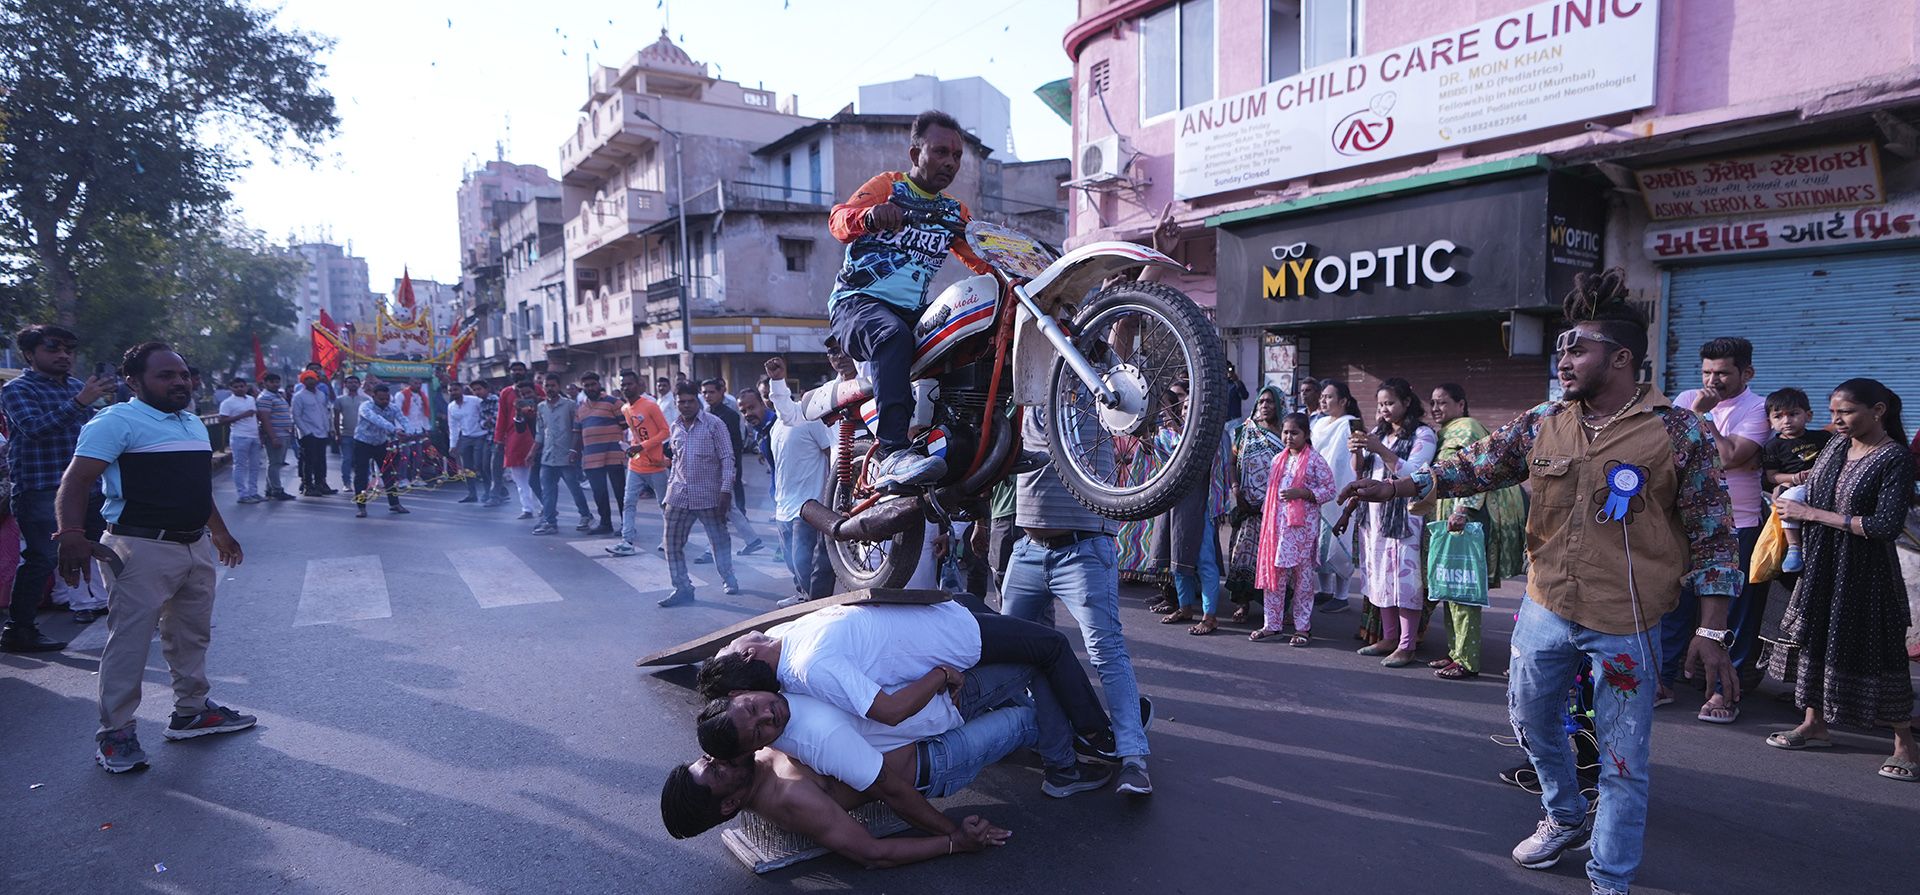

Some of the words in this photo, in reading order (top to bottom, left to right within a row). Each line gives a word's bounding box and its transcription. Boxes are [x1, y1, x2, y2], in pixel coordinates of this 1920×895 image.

[1181, 92, 1266, 137] ANJUM
[1276, 64, 1366, 111] CHILD
[1380, 29, 1480, 82] CARE
[1494, 0, 1643, 50] CLINIC
[1439, 72, 1463, 87] DR.
[1469, 59, 1509, 80] MOIN
[1514, 44, 1562, 68] KHAN
[1497, 63, 1564, 87] (Pediatrics)
[1439, 94, 1495, 113] Fellowship
[1496, 91, 1507, 100] in
[1539, 68, 1596, 91] (Mumbai)
[1439, 109, 1483, 125] Consultant
[1487, 97, 1540, 114] Pediatrician
[1543, 91, 1561, 102] and
[1564, 74, 1637, 97] Neonatologist
[1214, 175, 1242, 186] Sunday
[1243, 169, 1270, 180] Closed
[1655, 201, 1698, 217] ASHOK
[1701, 195, 1751, 214] XEROX
[1754, 194, 1769, 209] &
[1775, 184, 1876, 208] STATIONAR'S
[1551, 225, 1599, 251] MYOPTIC
[1262, 239, 1457, 299] MYOPTIC
[1436, 567, 1478, 583] FAISAL
